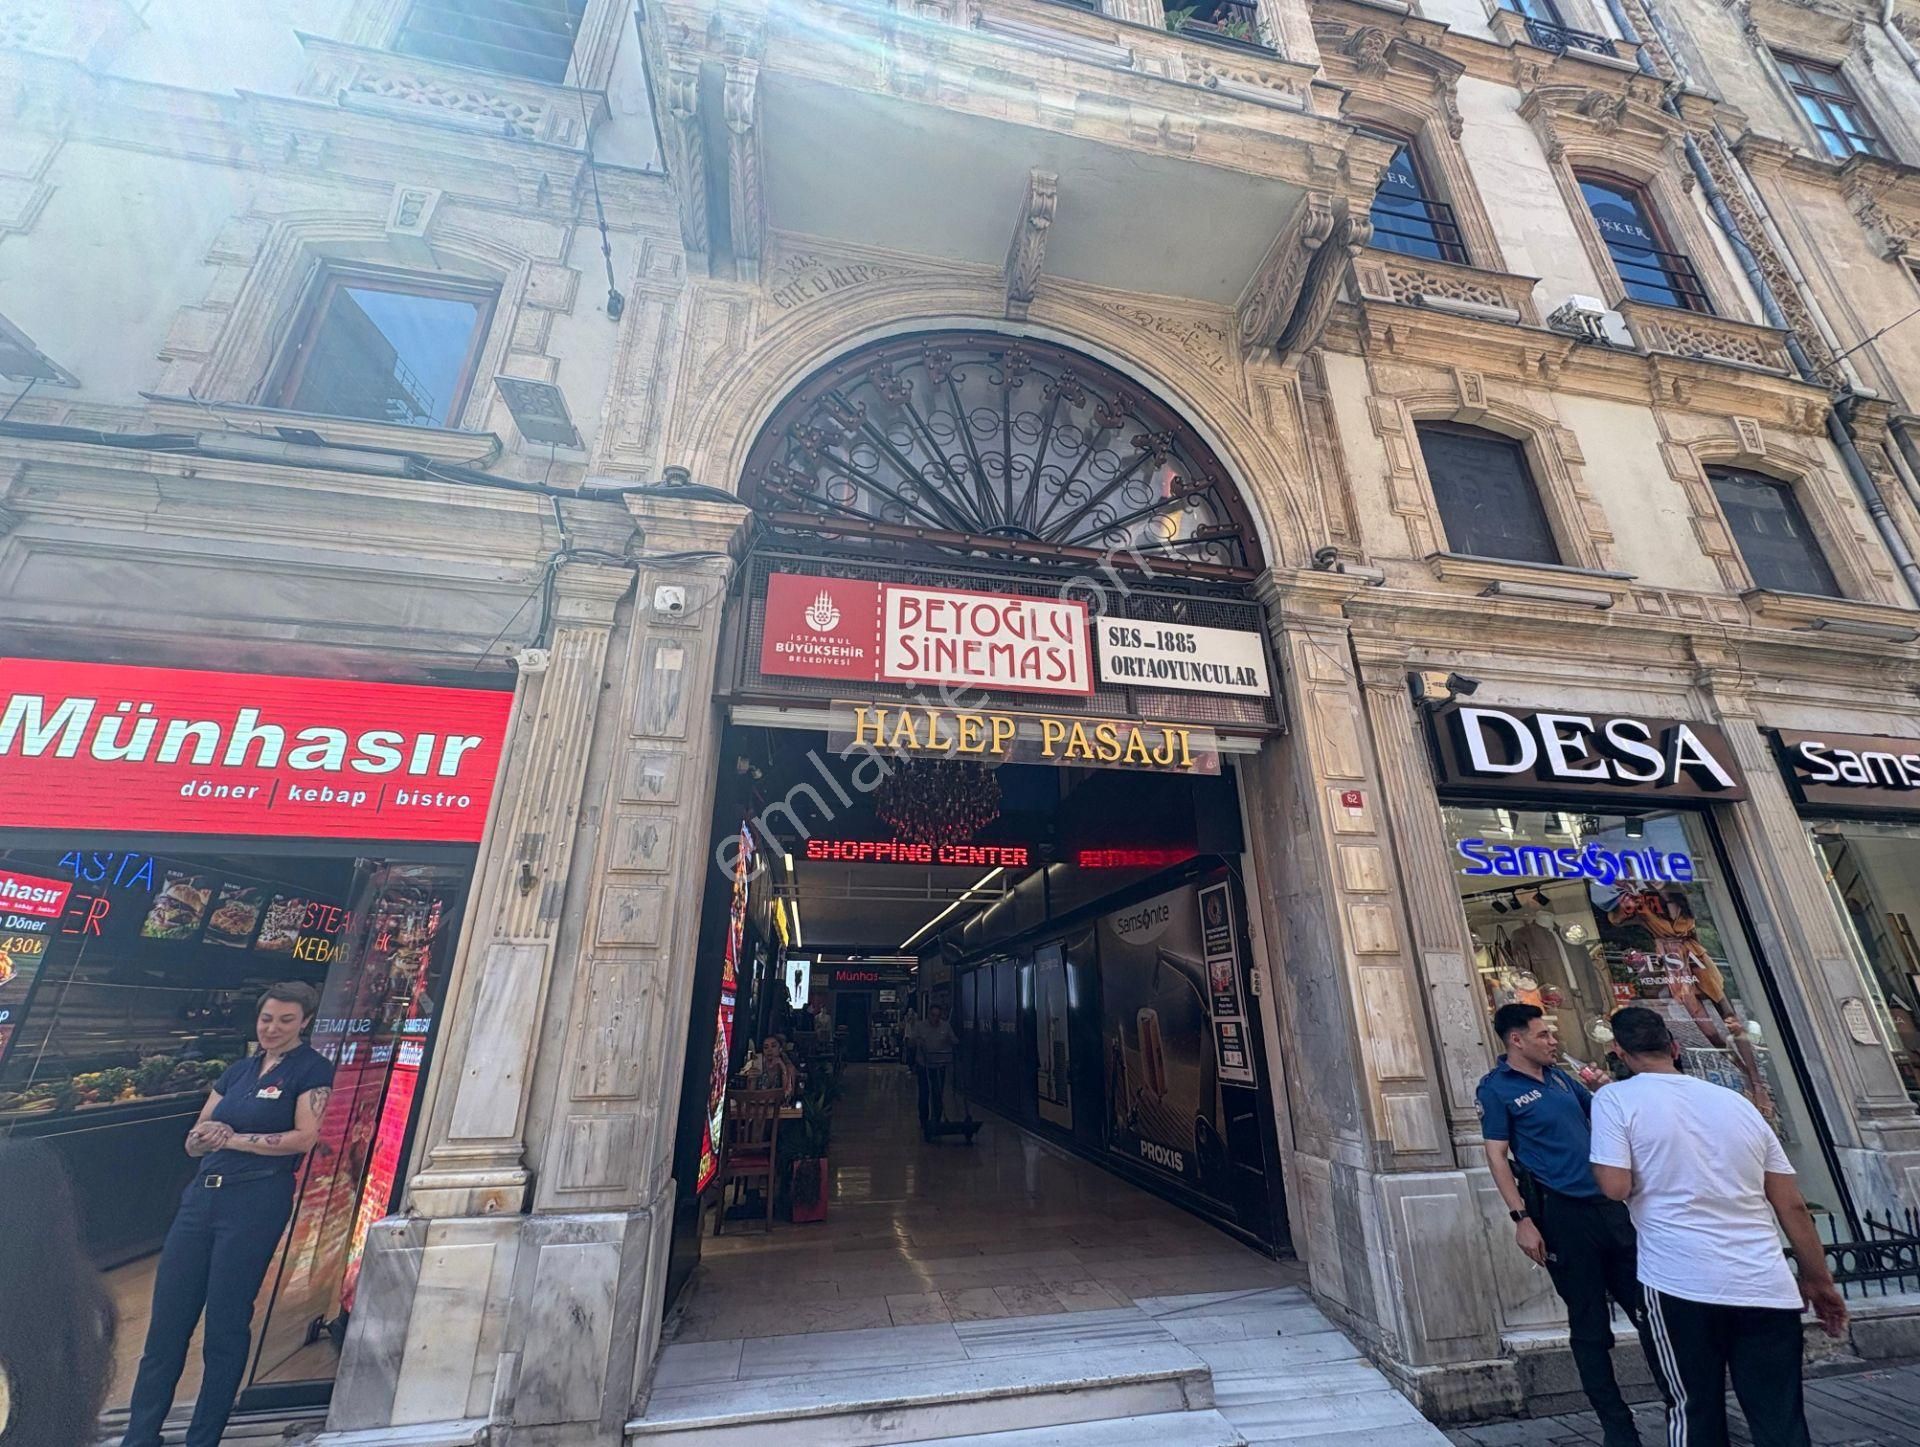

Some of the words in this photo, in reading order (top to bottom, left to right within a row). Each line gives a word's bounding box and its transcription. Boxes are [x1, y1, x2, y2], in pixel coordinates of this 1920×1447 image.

[898, 596, 1073, 644] BEYOĞLU
[790, 633, 851, 645] İSTANBUL
[788, 655, 850, 666] BELEDİYESİ
[1111, 655, 1259, 687] ORTAOYUNCULAR
[0, 693, 484, 777] Münhasır
[853, 707, 1017, 754] HALEP
[1039, 718, 1196, 768] PASAJI
[1459, 706, 1737, 788] DESA
[180, 780, 260, 799] döner
[287, 783, 368, 807] kebap
[396, 789, 471, 809] bistro
[938, 845, 1029, 866] CENTER
[1456, 837, 1694, 886] Samsonite
[5, 914, 46, 931] Döner
[1117, 904, 1170, 936] Samsonite
[1140, 1139, 1184, 1172] PROXIS
